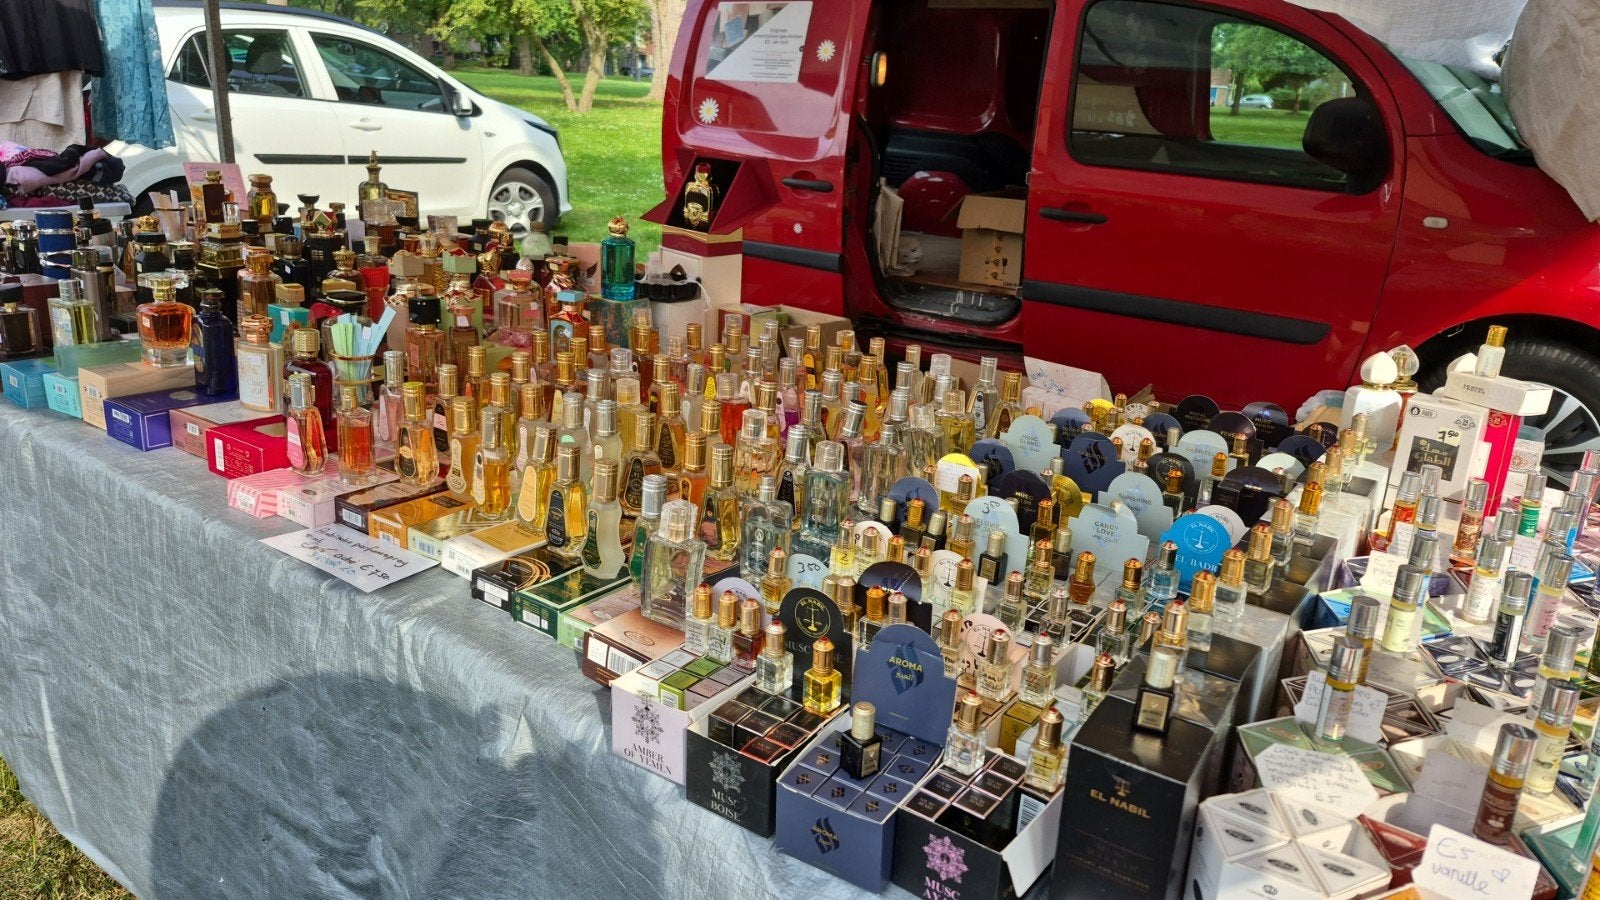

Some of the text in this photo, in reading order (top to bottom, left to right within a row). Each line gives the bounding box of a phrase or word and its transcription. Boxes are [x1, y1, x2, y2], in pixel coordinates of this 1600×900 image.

[1118, 493, 1152, 506] SUNSHINE
[1094, 520, 1120, 532] CANDY
[1096, 528, 1115, 538] LOVE
[1190, 557, 1217, 572] BADR
[889, 656, 924, 673] AROMA
[623, 746, 672, 775] OF YEMEN
[631, 742, 664, 764] AMBER
[1089, 788, 1152, 820] EL NABIL
[924, 876, 961, 900] MUSC
